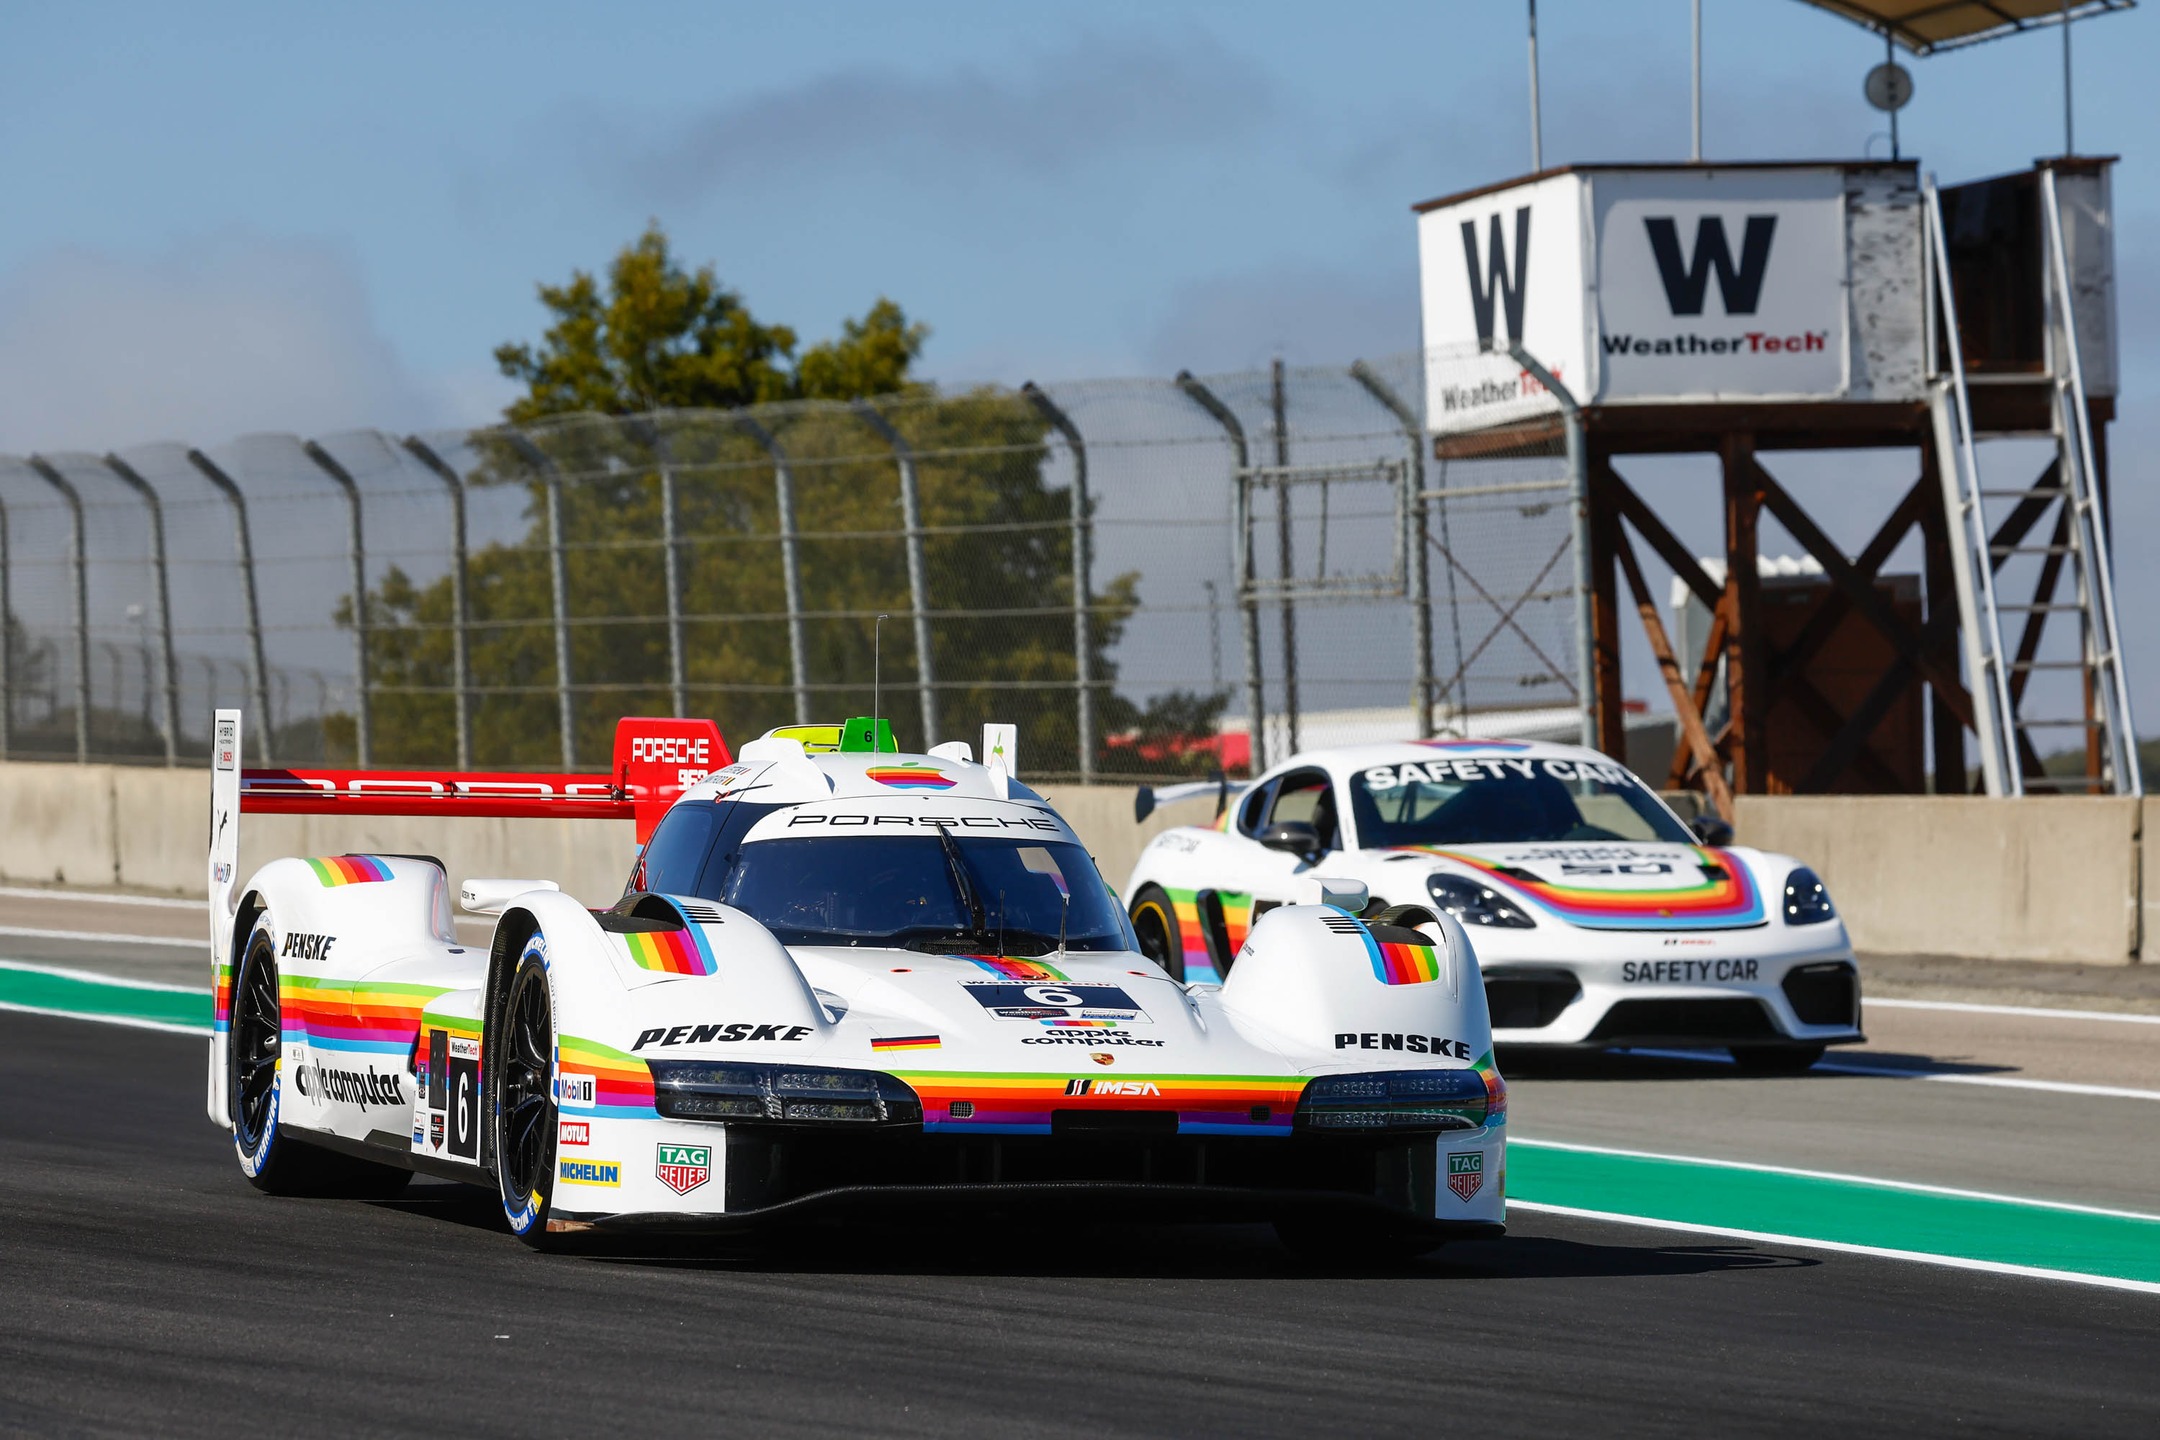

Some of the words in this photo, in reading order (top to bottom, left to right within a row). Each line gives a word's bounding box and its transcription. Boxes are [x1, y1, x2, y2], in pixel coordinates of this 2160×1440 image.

[1644, 213, 1778, 316] W
[1461, 205, 1531, 354] W
[1604, 331, 1825, 358] WeatherTech
[864, 730, 872, 743] 6
[632, 737, 709, 764] PORSCHE
[1364, 759, 1536, 791] SAFETY
[1543, 760, 1634, 787] CAR
[788, 815, 1060, 831] PORSCHE
[281, 932, 337, 961] PENSKE
[1622, 961, 1711, 983] SAFETY
[1716, 959, 1759, 981] CAR
[1023, 986, 1084, 1006] 6
[631, 1024, 814, 1052] PENSKE
[1021, 1037, 1165, 1047] computer
[1045, 1029, 1131, 1038] apple
[1335, 1033, 1471, 1060] PENSKE
[561, 1080, 581, 1101] Mobil
[1094, 1081, 1160, 1096] IMSA
[458, 1071, 468, 1144] 6
[560, 1125, 588, 1142] MOTUL
[662, 1148, 705, 1164] TAG
[1452, 1157, 1480, 1171] TAG
[560, 1162, 618, 1182] MICHELIN
[660, 1166, 706, 1190] HEUER
[1450, 1174, 1480, 1197] HEUER
